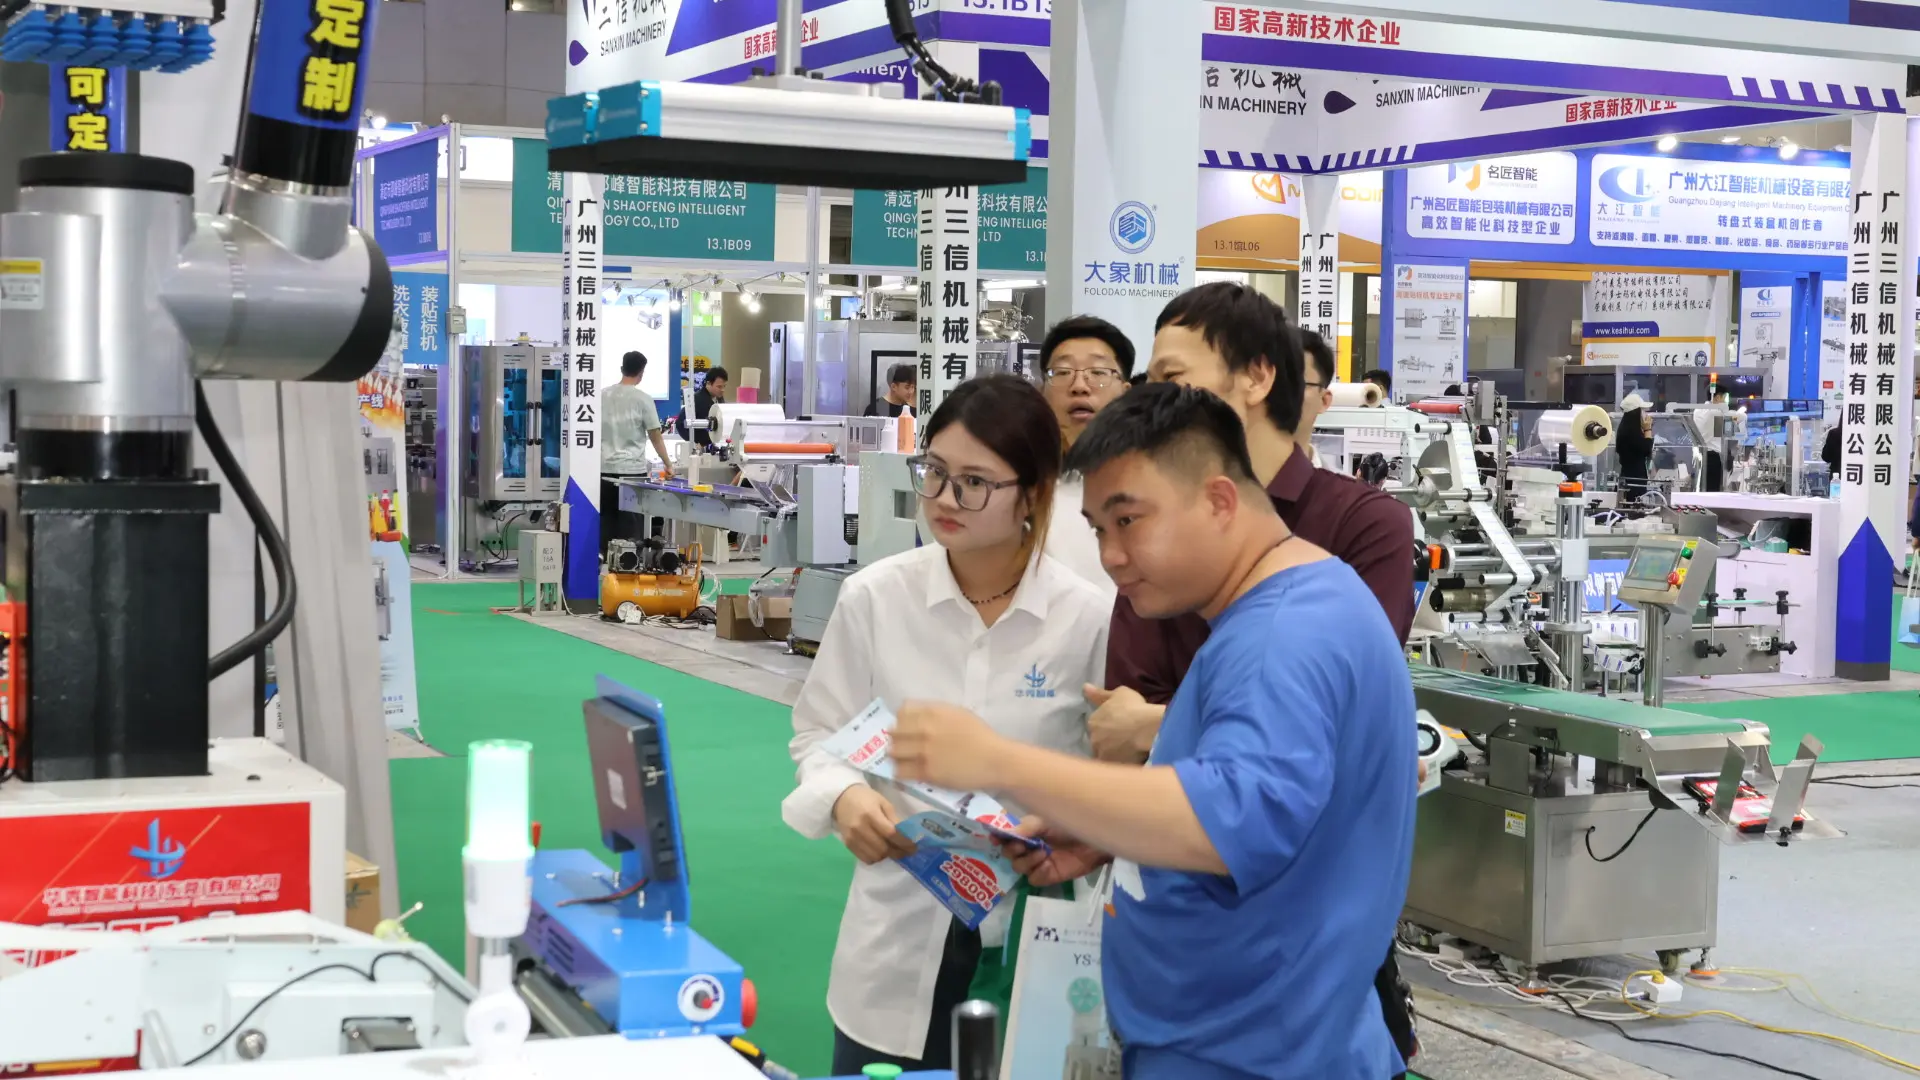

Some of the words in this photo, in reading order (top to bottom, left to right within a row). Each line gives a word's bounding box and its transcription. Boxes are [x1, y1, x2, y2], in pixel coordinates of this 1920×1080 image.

[1214, 6, 1401, 45] 国家高新技术企业
[600, 33, 625, 56] SANXIN
[626, 19, 666, 48] MACHINERY
[744, 17, 818, 59] 国家高新企业
[1218, 96, 1307, 115] MACHINERY
[1376, 88, 1415, 107] SANXIN
[1487, 165, 1538, 181] 名匠智能
[547, 171, 747, 200] 清峰智能科技有限公司
[613, 200, 676, 213] SHAOFENG
[678, 202, 746, 216] INTELLIGENT
[1668, 195, 1708, 207] Guangzhou
[659, 216, 680, 229] LTD
[1000, 216, 1047, 229] INTELLIGE
[1421, 215, 1561, 236] 高效智能化科技型企业
[707, 238, 751, 251] 13.1B09
[1084, 260, 1180, 286] 大象机械
[1084, 287, 1127, 297] FOLODAO
[1128, 288, 1180, 298] MACHINERY
[419, 285, 439, 352] 装贴标机
[575, 198, 598, 449] 广州三信机械有限公司
[1594, 326, 1650, 336] www.kesihui.com
[1846, 190, 1873, 486] 广州三信机械有限公司
[1874, 190, 1900, 486] 广州三信机械有限公司
